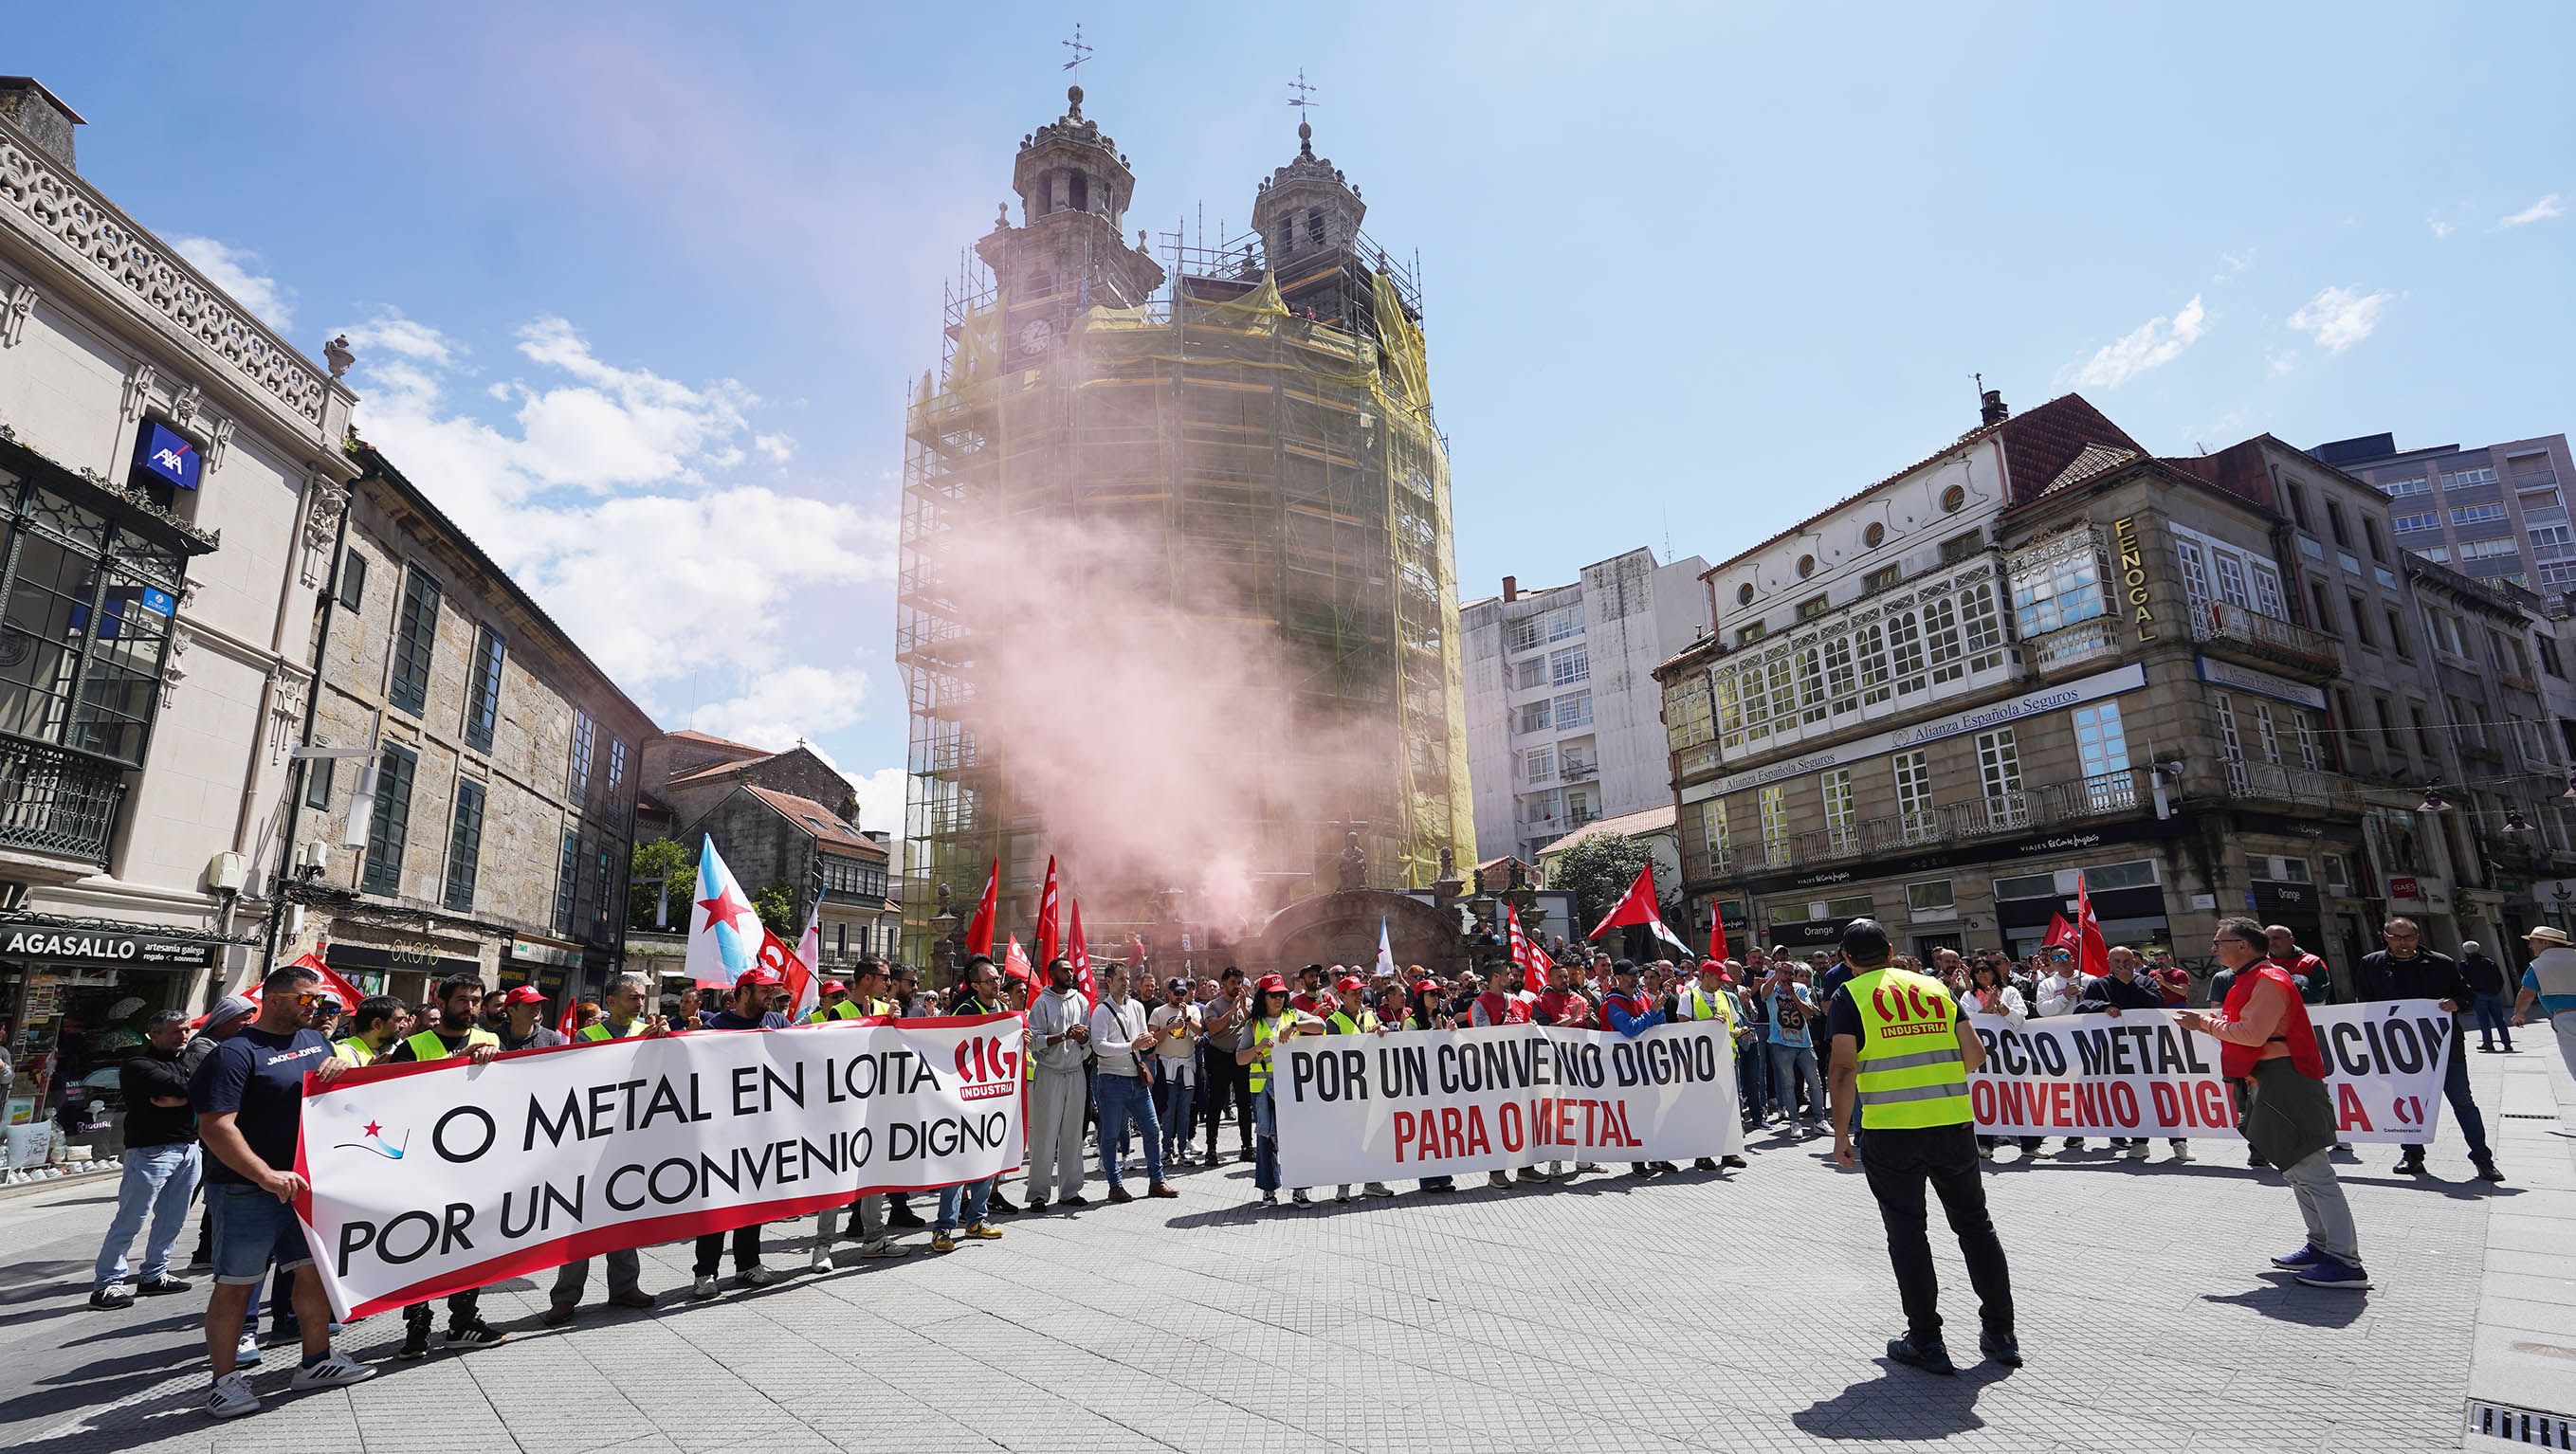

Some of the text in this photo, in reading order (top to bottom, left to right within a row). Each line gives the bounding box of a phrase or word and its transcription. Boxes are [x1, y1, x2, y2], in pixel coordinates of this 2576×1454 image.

[153, 446, 185, 475] AXA
[2114, 517, 2157, 642] FENOGAL
[1915, 689, 2079, 740] Alianza Española Seguros
[1726, 754, 1836, 790] Alianza Española Seguros
[2019, 843, 2047, 852] VIAJES
[2278, 887, 2300, 902] Orange
[2392, 883, 2418, 892] GAES
[6, 932, 136, 959] AGASALLO
[144, 943, 205, 955] artesanía galega
[1804, 925, 1834, 936] Orange
[1873, 984, 1946, 1023] CIG
[1882, 1024, 1946, 1038] INDUSTRIA
[2313, 1006, 2451, 1077] UCIÓN
[954, 1036, 1017, 1082] CIG
[1291, 1035, 1716, 1102] POR UN CONVENIO DIGNO
[1972, 1026, 2211, 1077] RCIO METAL
[432, 1050, 941, 1164] O METAL EN LOITA
[960, 1083, 1013, 1099] INDUSTRIA
[1972, 1080, 2140, 1128] ONVENIO
[1393, 1099, 1642, 1163] PARA O METAL
[338, 1111, 1007, 1278] POR UN CONVENIO DIGNO
